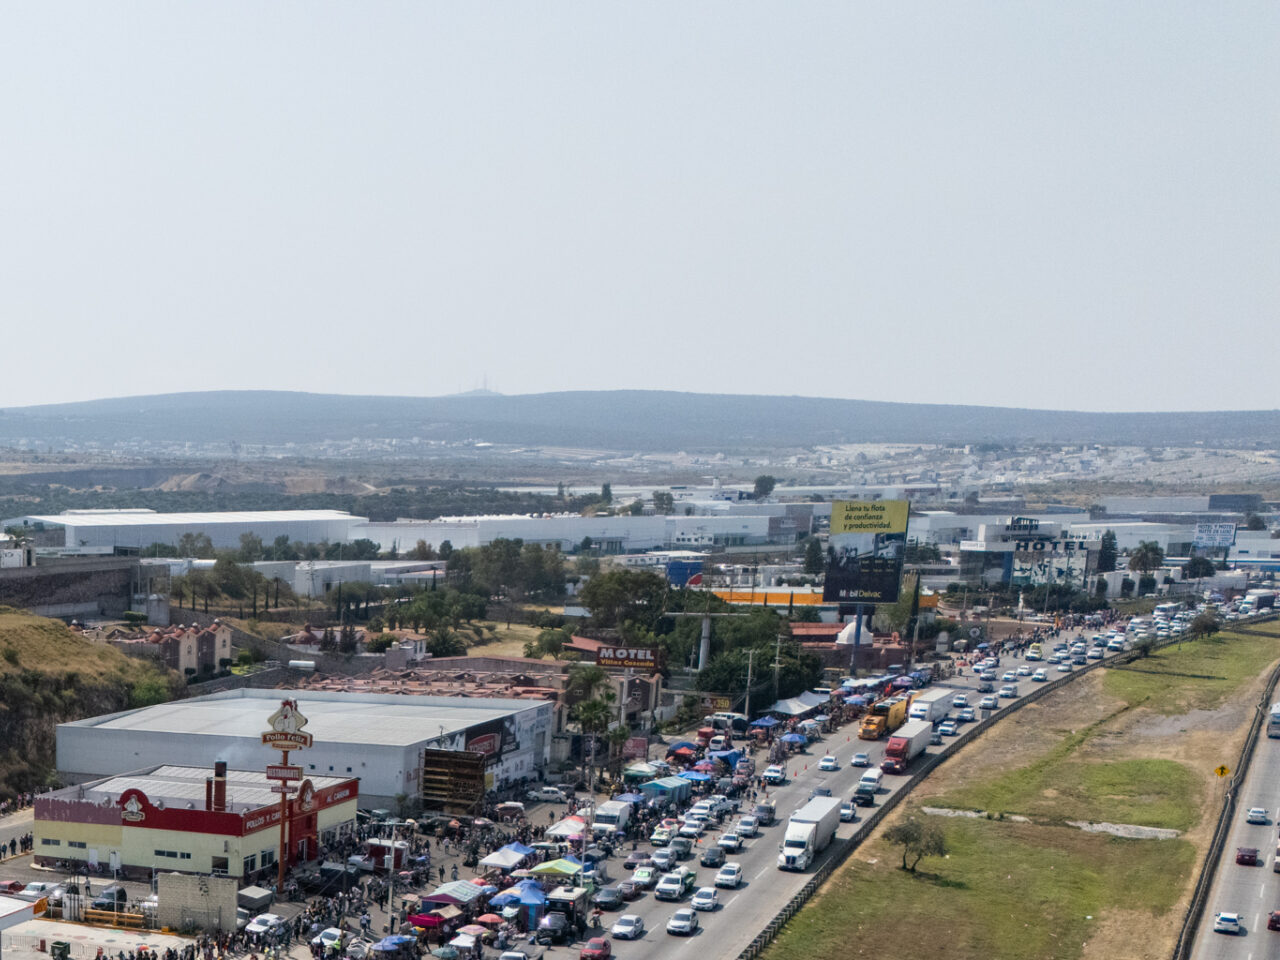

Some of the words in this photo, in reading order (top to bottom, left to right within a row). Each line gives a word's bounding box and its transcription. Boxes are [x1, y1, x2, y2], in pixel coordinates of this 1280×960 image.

[845, 503, 862, 512] Llena
[844, 513, 852, 521] de
[853, 513, 883, 521] confianza
[1015, 541, 1089, 551] HOTEL
[599, 649, 655, 660] MOTEL
[287, 735, 305, 743] Feliz
[246, 816, 265, 830] POLLOS
